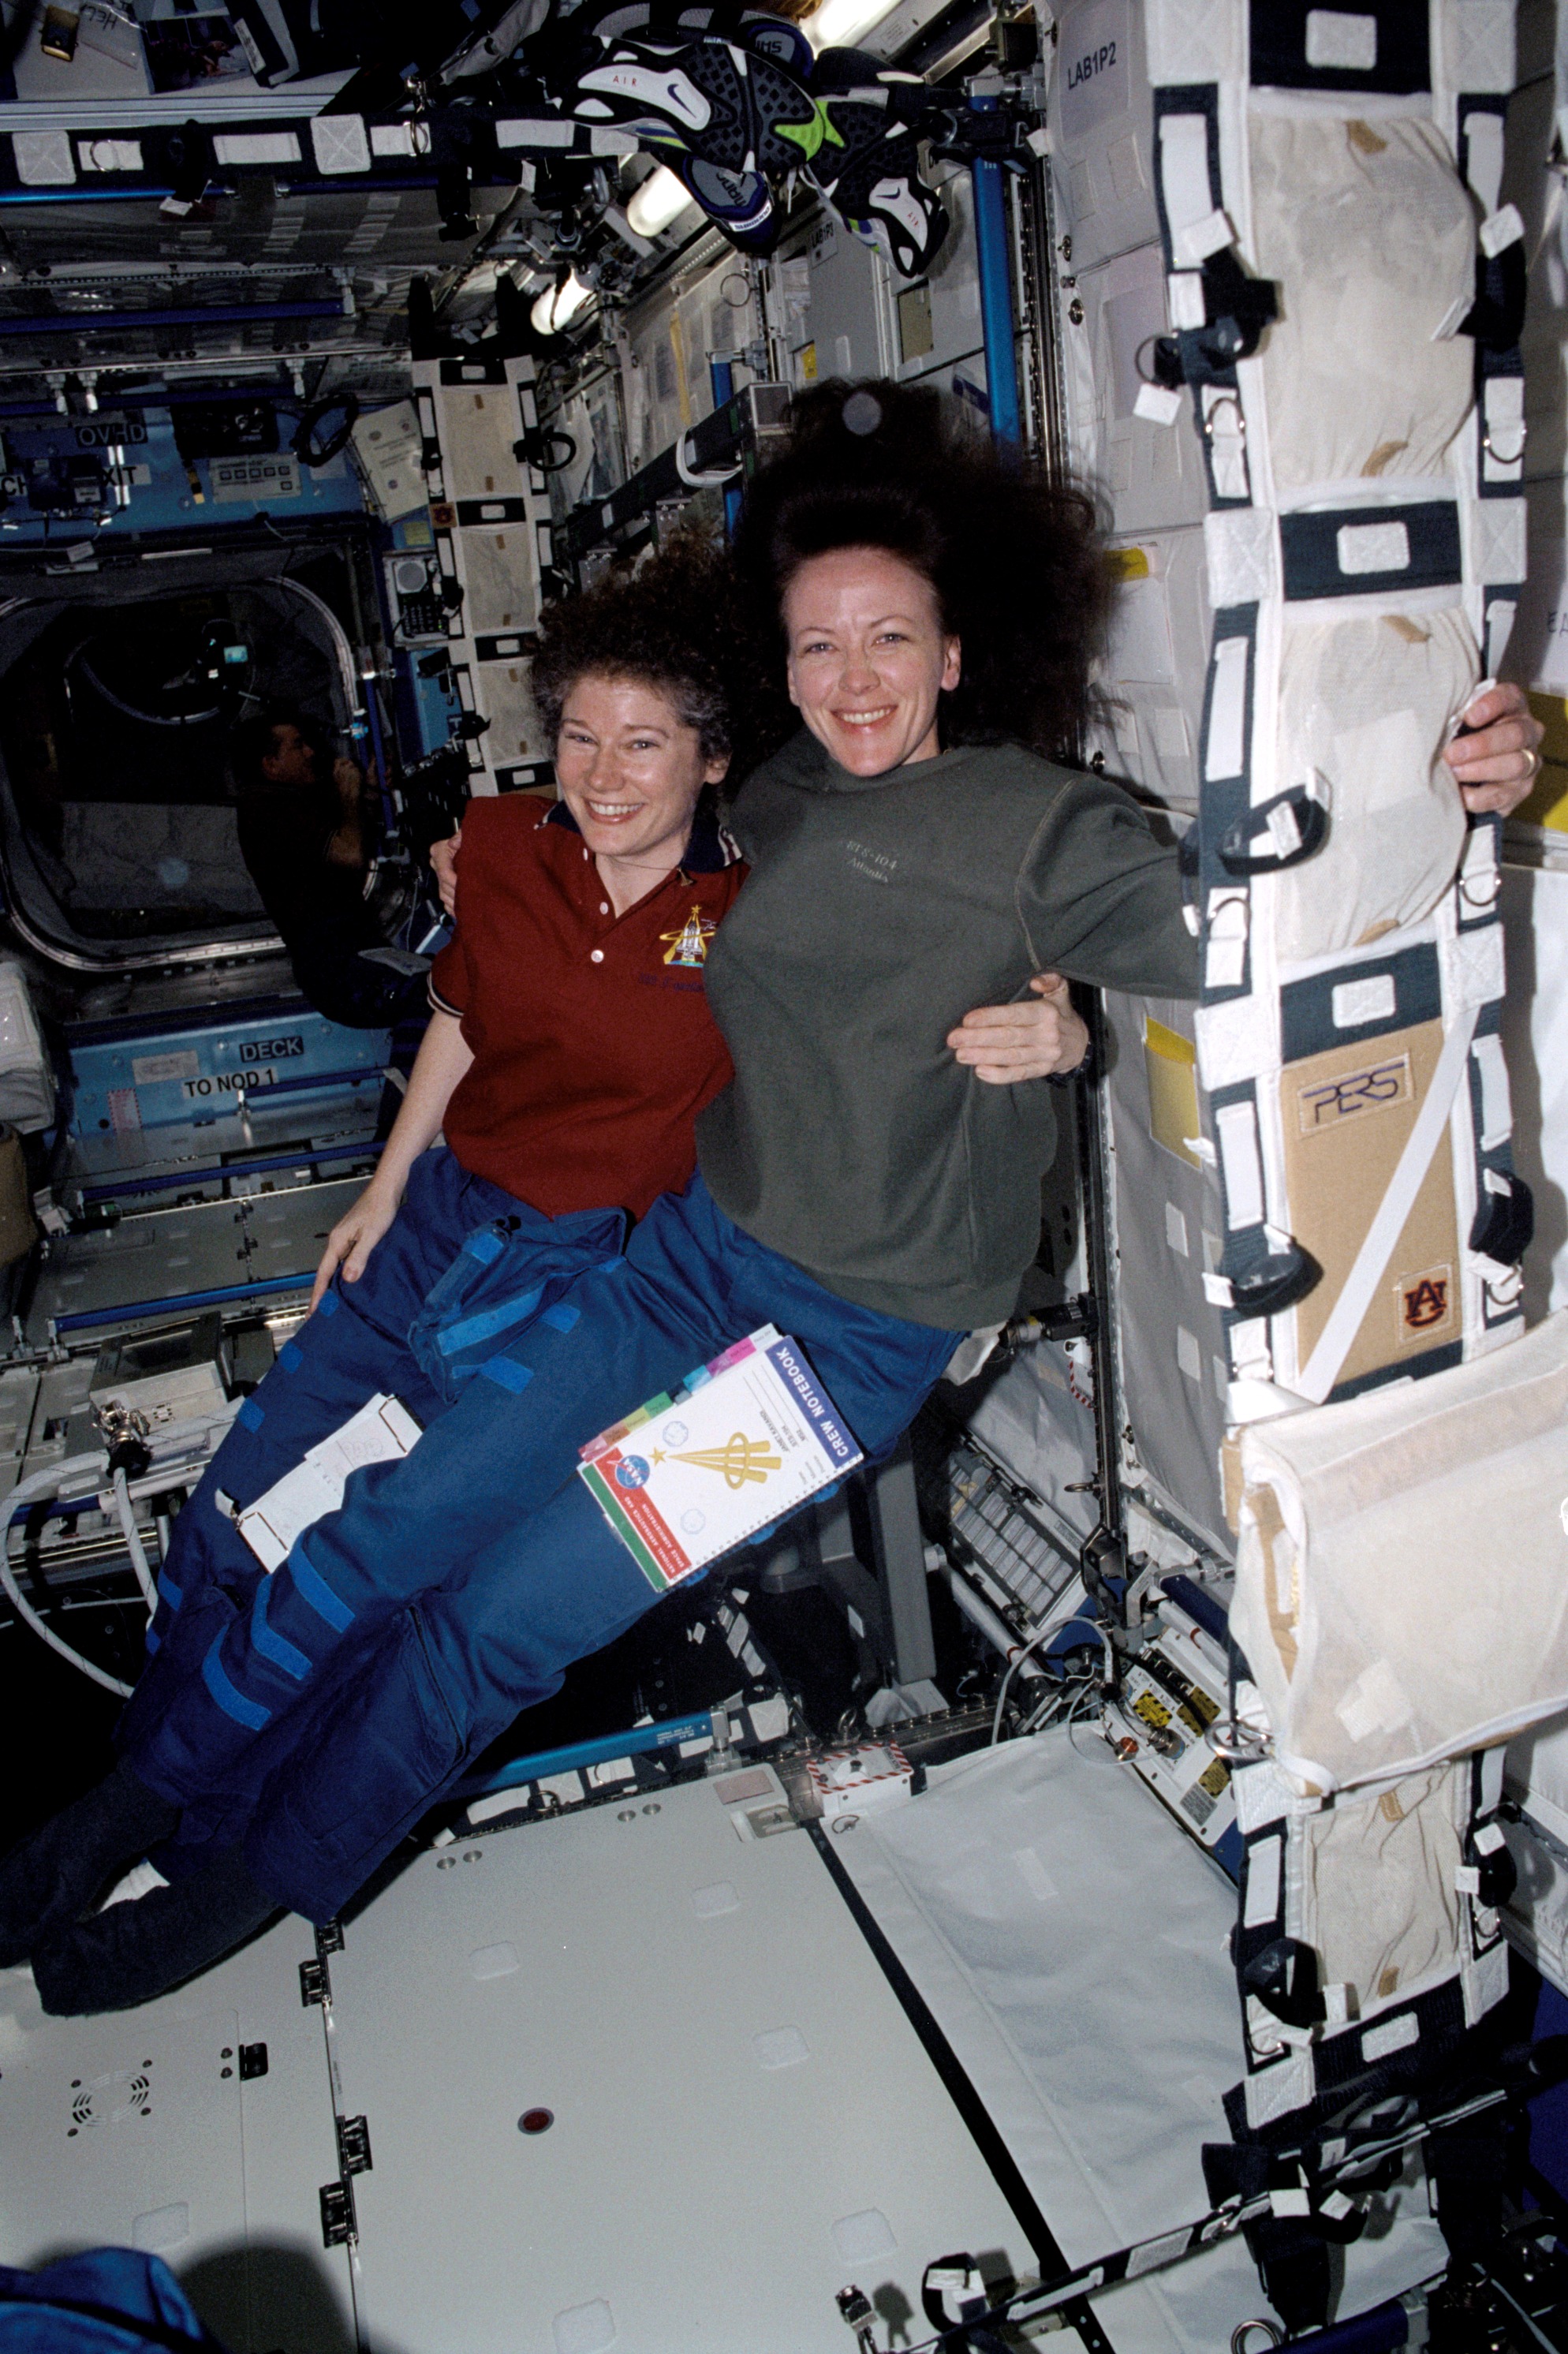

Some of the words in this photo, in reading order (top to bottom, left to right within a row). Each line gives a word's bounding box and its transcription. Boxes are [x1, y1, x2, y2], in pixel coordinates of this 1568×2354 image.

[1068, 41, 1116, 90] LAB1P2
[612, 75, 637, 87] AIR
[80, 424, 145, 447] OVHD
[242, 1038, 303, 1061] DECK
[185, 1079, 211, 1097] TO
[218, 1071, 259, 1093] NOD
[267, 1068, 274, 1085] 1
[1303, 1062, 1405, 1123] PERS
[776, 1346, 826, 1418] NOTEBOOK
[759, 1410, 778, 1436] KAVANDI
[774, 1434, 789, 1453] JANET
[820, 1419, 849, 1457] CREW
[624, 1457, 644, 1485] NASA
[624, 1496, 635, 1509] AND
[633, 1508, 659, 1547] AERONAUTICS
[641, 1503, 673, 1549] ADMINISTRATION
[657, 1547, 676, 1574] NATIONAL
[670, 1549, 685, 1569] SPACE
